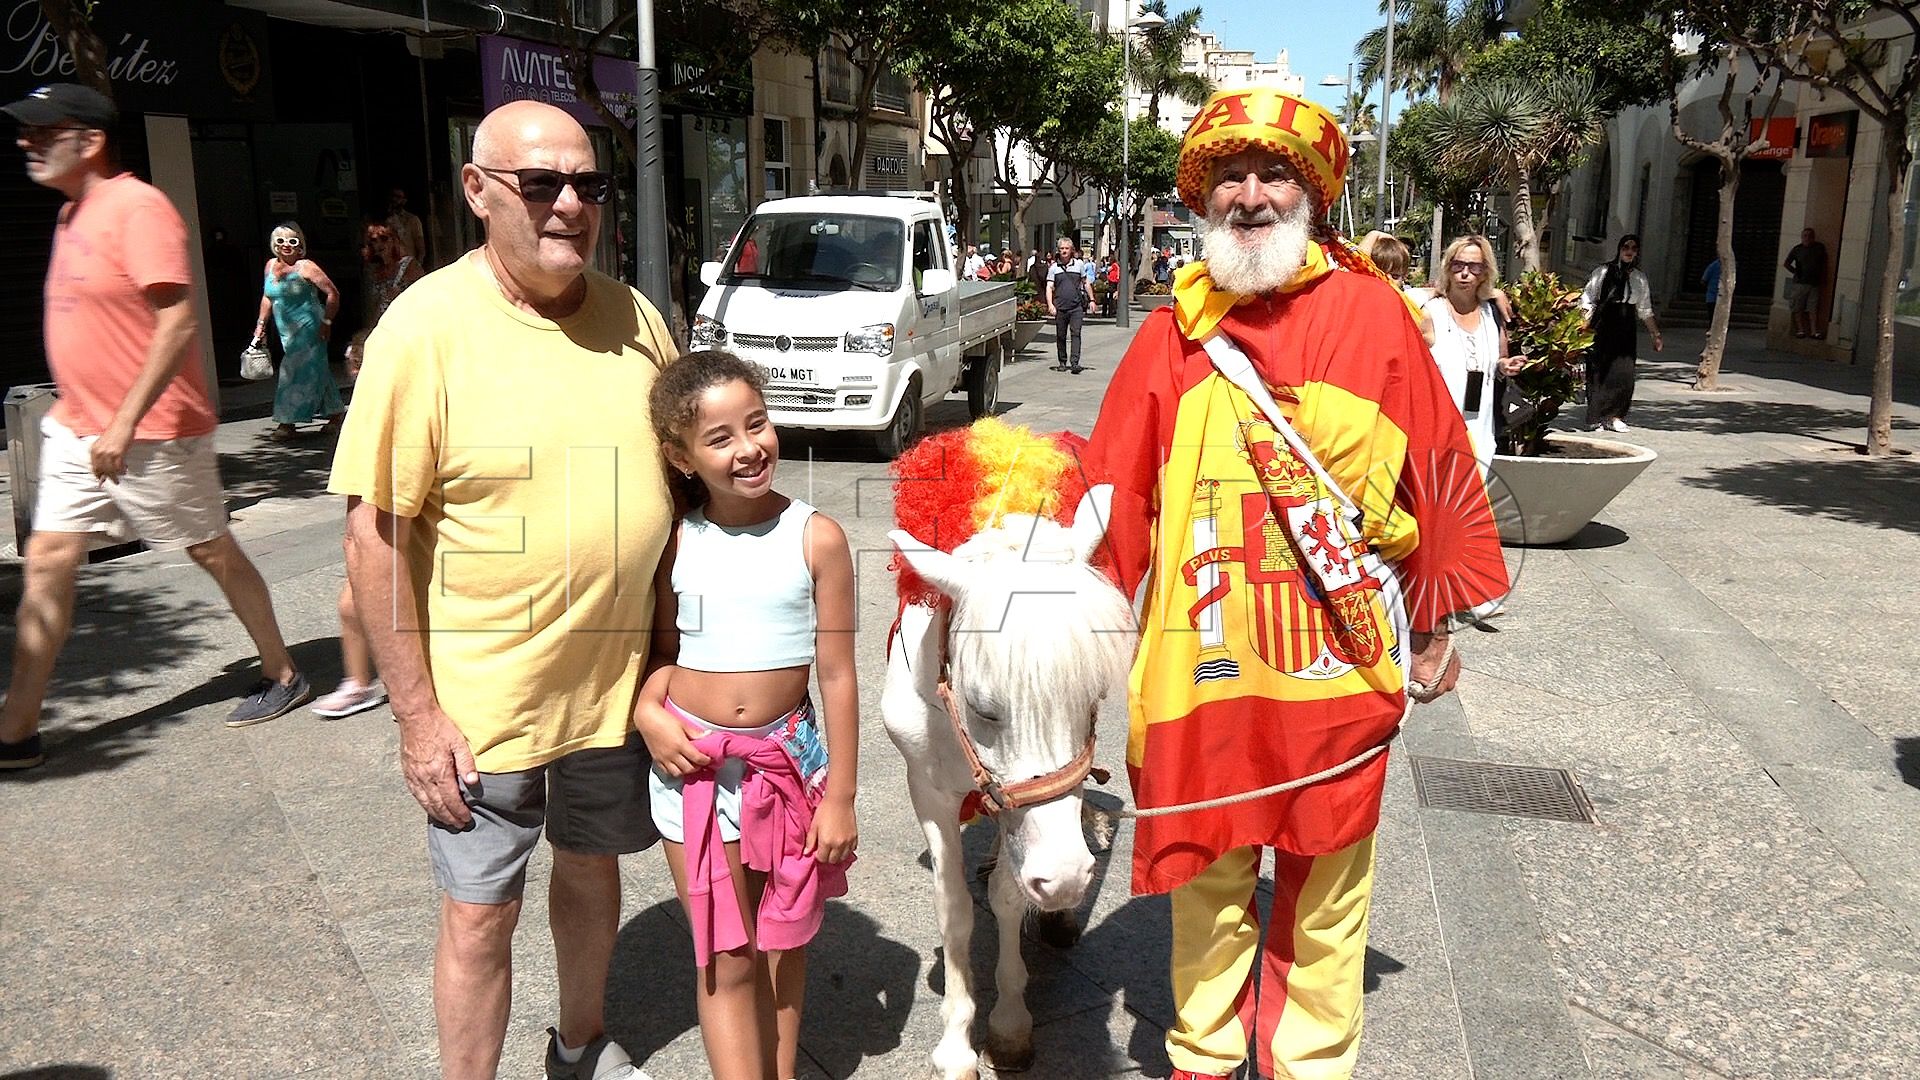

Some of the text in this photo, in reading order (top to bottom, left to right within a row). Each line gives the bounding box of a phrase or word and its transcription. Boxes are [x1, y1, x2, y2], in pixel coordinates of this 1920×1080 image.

[0, 0, 178, 86] Beítez
[1183, 93, 1347, 180] AIN
[1753, 146, 1790, 157] range
[790, 368, 814, 381] MGT
[1189, 549, 1231, 571] PLVS
